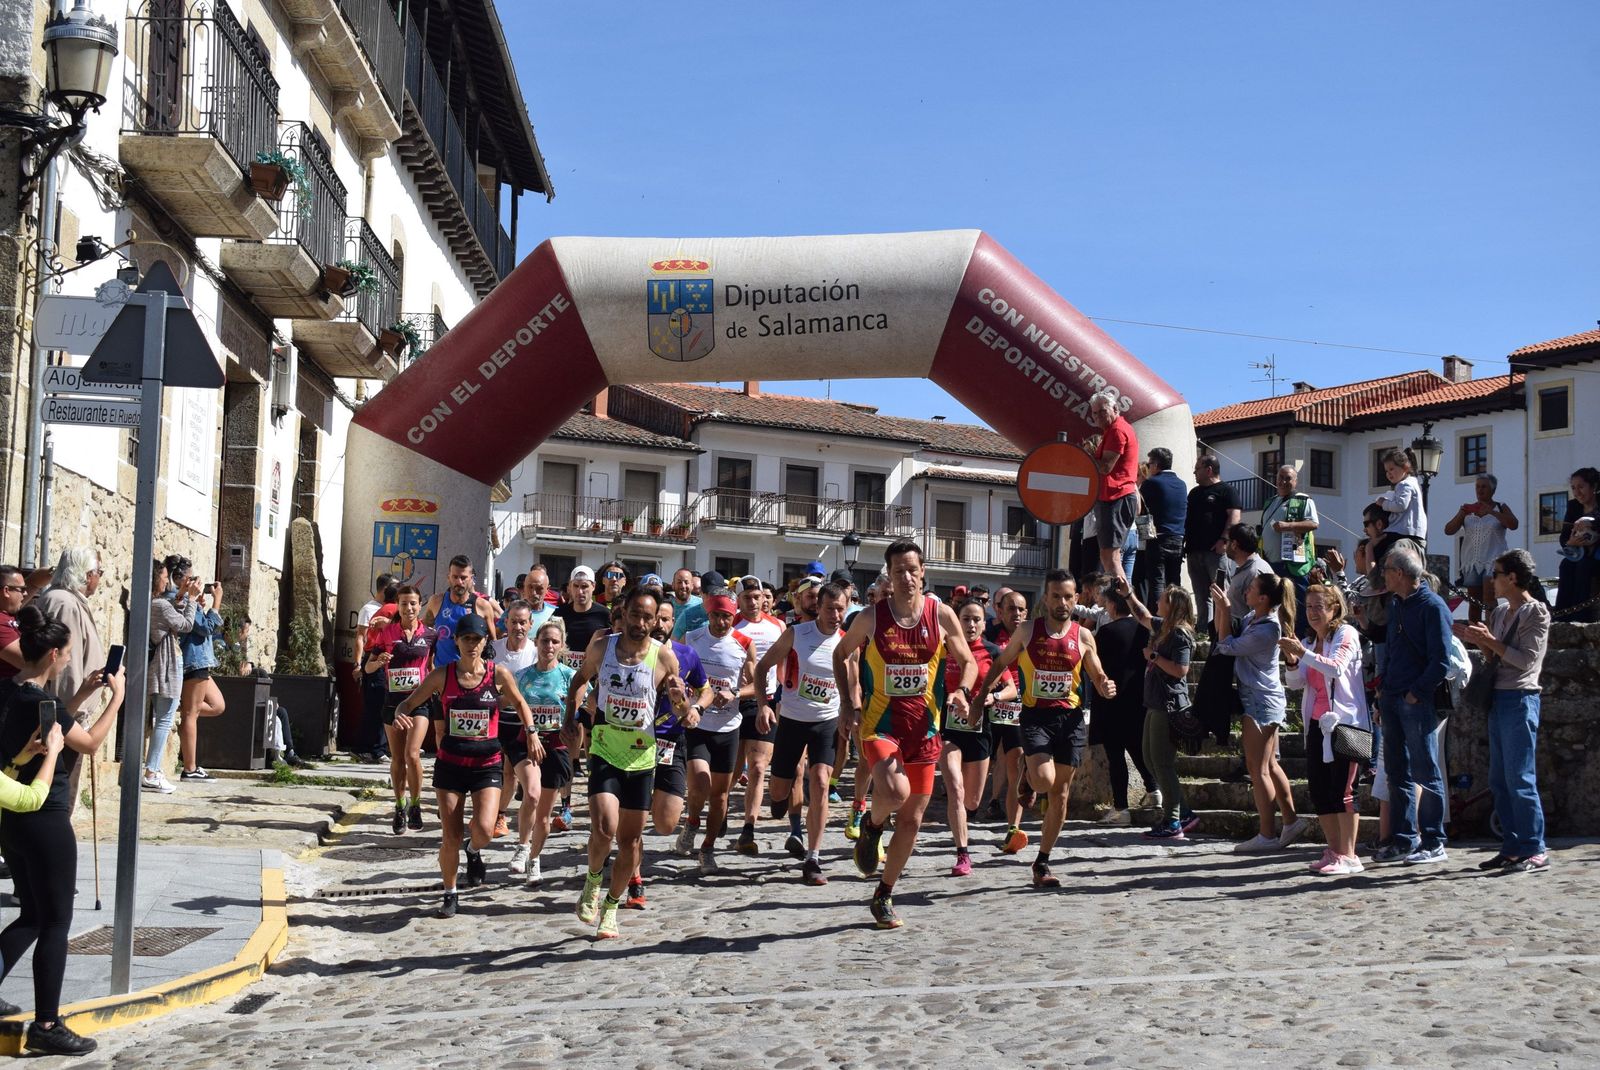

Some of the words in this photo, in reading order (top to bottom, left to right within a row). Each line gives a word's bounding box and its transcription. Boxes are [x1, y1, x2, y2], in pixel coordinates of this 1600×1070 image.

[725, 278, 860, 312] Diputación
[725, 321, 748, 339] de
[758, 312, 889, 338] Salamanca
[977, 287, 1025, 328] CON
[1022, 323, 1134, 414] NUESTROS
[407, 400, 453, 444] CON
[450, 379, 482, 405] EL
[477, 293, 571, 380] DEPORTE
[48, 400, 108, 423] Restaurante
[109, 408, 118, 422] El
[118, 409, 141, 424] Ruedo
[388, 669, 419, 677] bedunia
[885, 665, 928, 676] bedunia
[1034, 671, 1072, 682] bedunia
[394, 676, 414, 686] 274
[801, 673, 836, 689] bedunia
[893, 676, 921, 689] 289
[1040, 681, 1065, 693] 292
[805, 684, 827, 698] 206
[607, 694, 647, 709] bedunia
[450, 711, 489, 720] bedunia
[532, 714, 553, 725] 201
[612, 706, 639, 721] 279
[994, 708, 1015, 720] 258
[457, 718, 481, 731] 294
